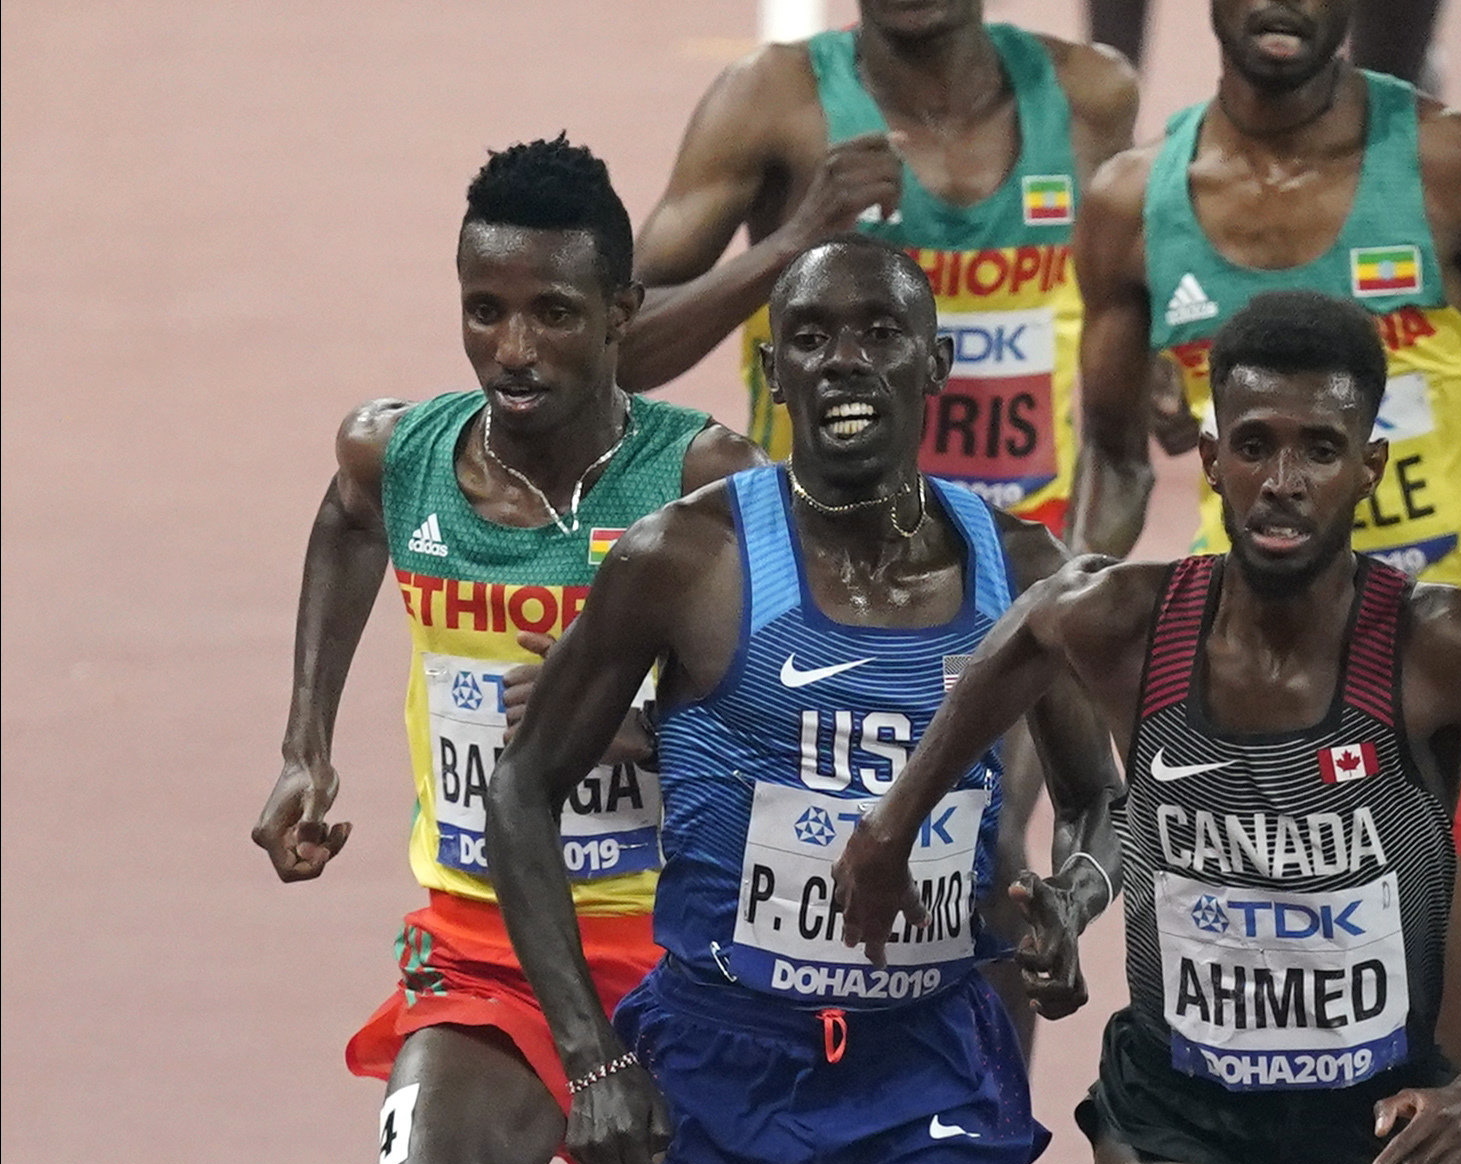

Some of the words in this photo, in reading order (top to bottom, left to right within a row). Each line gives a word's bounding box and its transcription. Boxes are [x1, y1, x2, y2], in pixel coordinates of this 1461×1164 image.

[921, 392, 1037, 459] RIS
[440, 736, 643, 815] BAGA
[1157, 804, 1388, 878] CANADA
[1227, 898, 1366, 939] TDK
[771, 958, 942, 999] DOHA2019
[1176, 957, 1389, 1030] AHMED
[1203, 1048, 1374, 1085] DOHA2019
